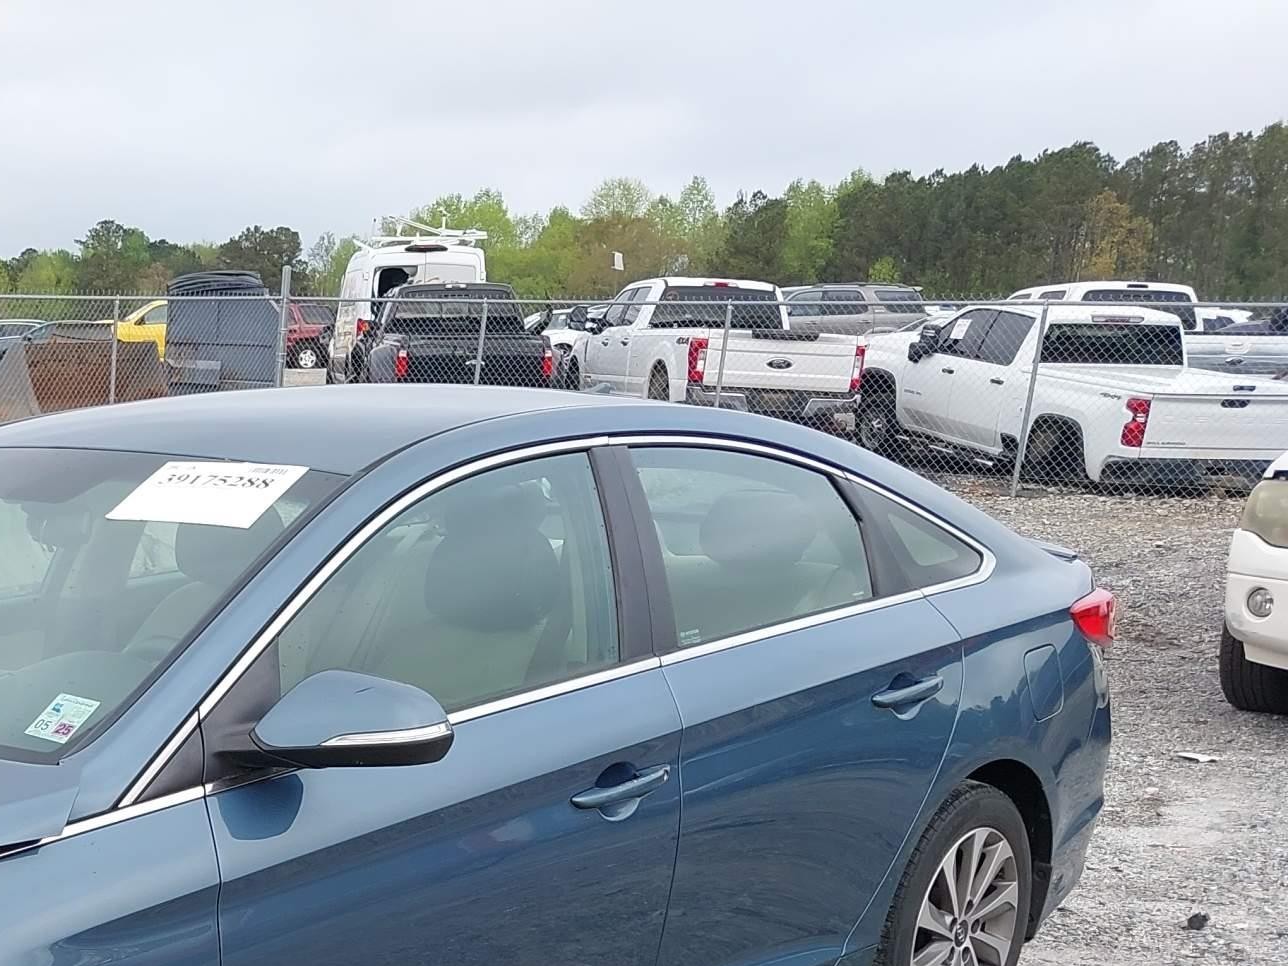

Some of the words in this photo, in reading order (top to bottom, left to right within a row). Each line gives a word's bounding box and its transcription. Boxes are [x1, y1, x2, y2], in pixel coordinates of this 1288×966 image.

[157, 473, 275, 490] 39175288
[34, 719, 52, 730] 05
[54, 723, 73, 735] 25
